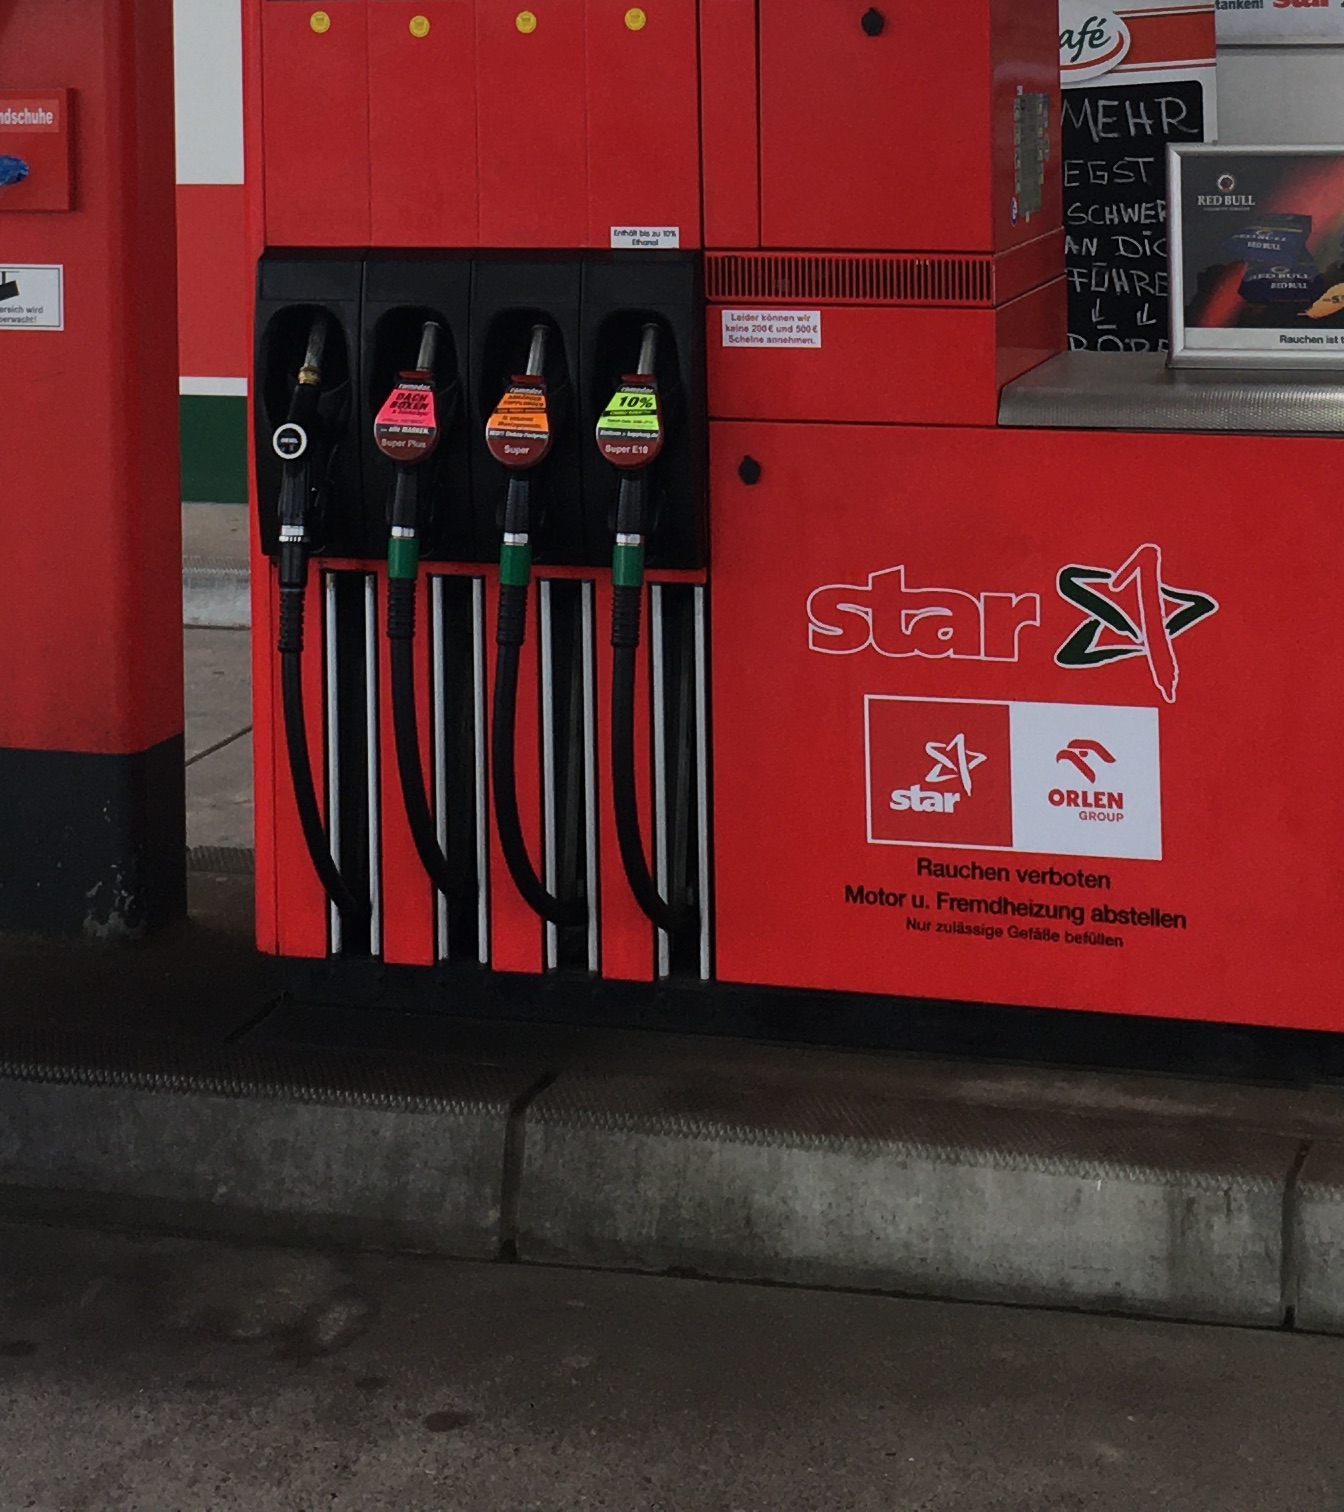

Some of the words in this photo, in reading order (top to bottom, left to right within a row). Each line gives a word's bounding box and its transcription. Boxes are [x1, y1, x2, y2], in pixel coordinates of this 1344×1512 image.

[1060, 15, 1112, 62] afé
[1061, 96, 1199, 143] MEHR
[1197, 195, 1223, 206] RED
[1224, 195, 1256, 206] BULL
[26, 305, 43, 313] wird
[731, 313, 758, 321] Leider
[761, 313, 795, 321] können
[797, 314, 811, 322] wir
[725, 324, 749, 333] keine
[776, 325, 793, 333] und
[728, 335, 764, 344] Scheine
[1279, 334, 1324, 345] Rauchen
[1326, 334, 1338, 345] ist
[619, 396, 653, 408] 10%
[381, 438, 406, 449] Super
[407, 439, 427, 448] Plus
[504, 444, 530, 455] Super
[605, 444, 630, 455] Super
[632, 444, 649, 454] E10
[807, 565, 1040, 662] star
[889, 785, 960, 814] star
[1048, 789, 1124, 810] ORLEN
[1079, 810, 1124, 823] GROUP
[917, 857, 1011, 882] Rauchen
[1016, 866, 1111, 890] verboten
[844, 885, 907, 909] Motor
[912, 893, 931, 910] u.
[935, 892, 1085, 926] Fremdheizung
[1090, 904, 1187, 930] abstellen
[906, 916, 932, 932] Nur
[935, 920, 1004, 940] zulässige
[1064, 928, 1124, 948] befüllen
